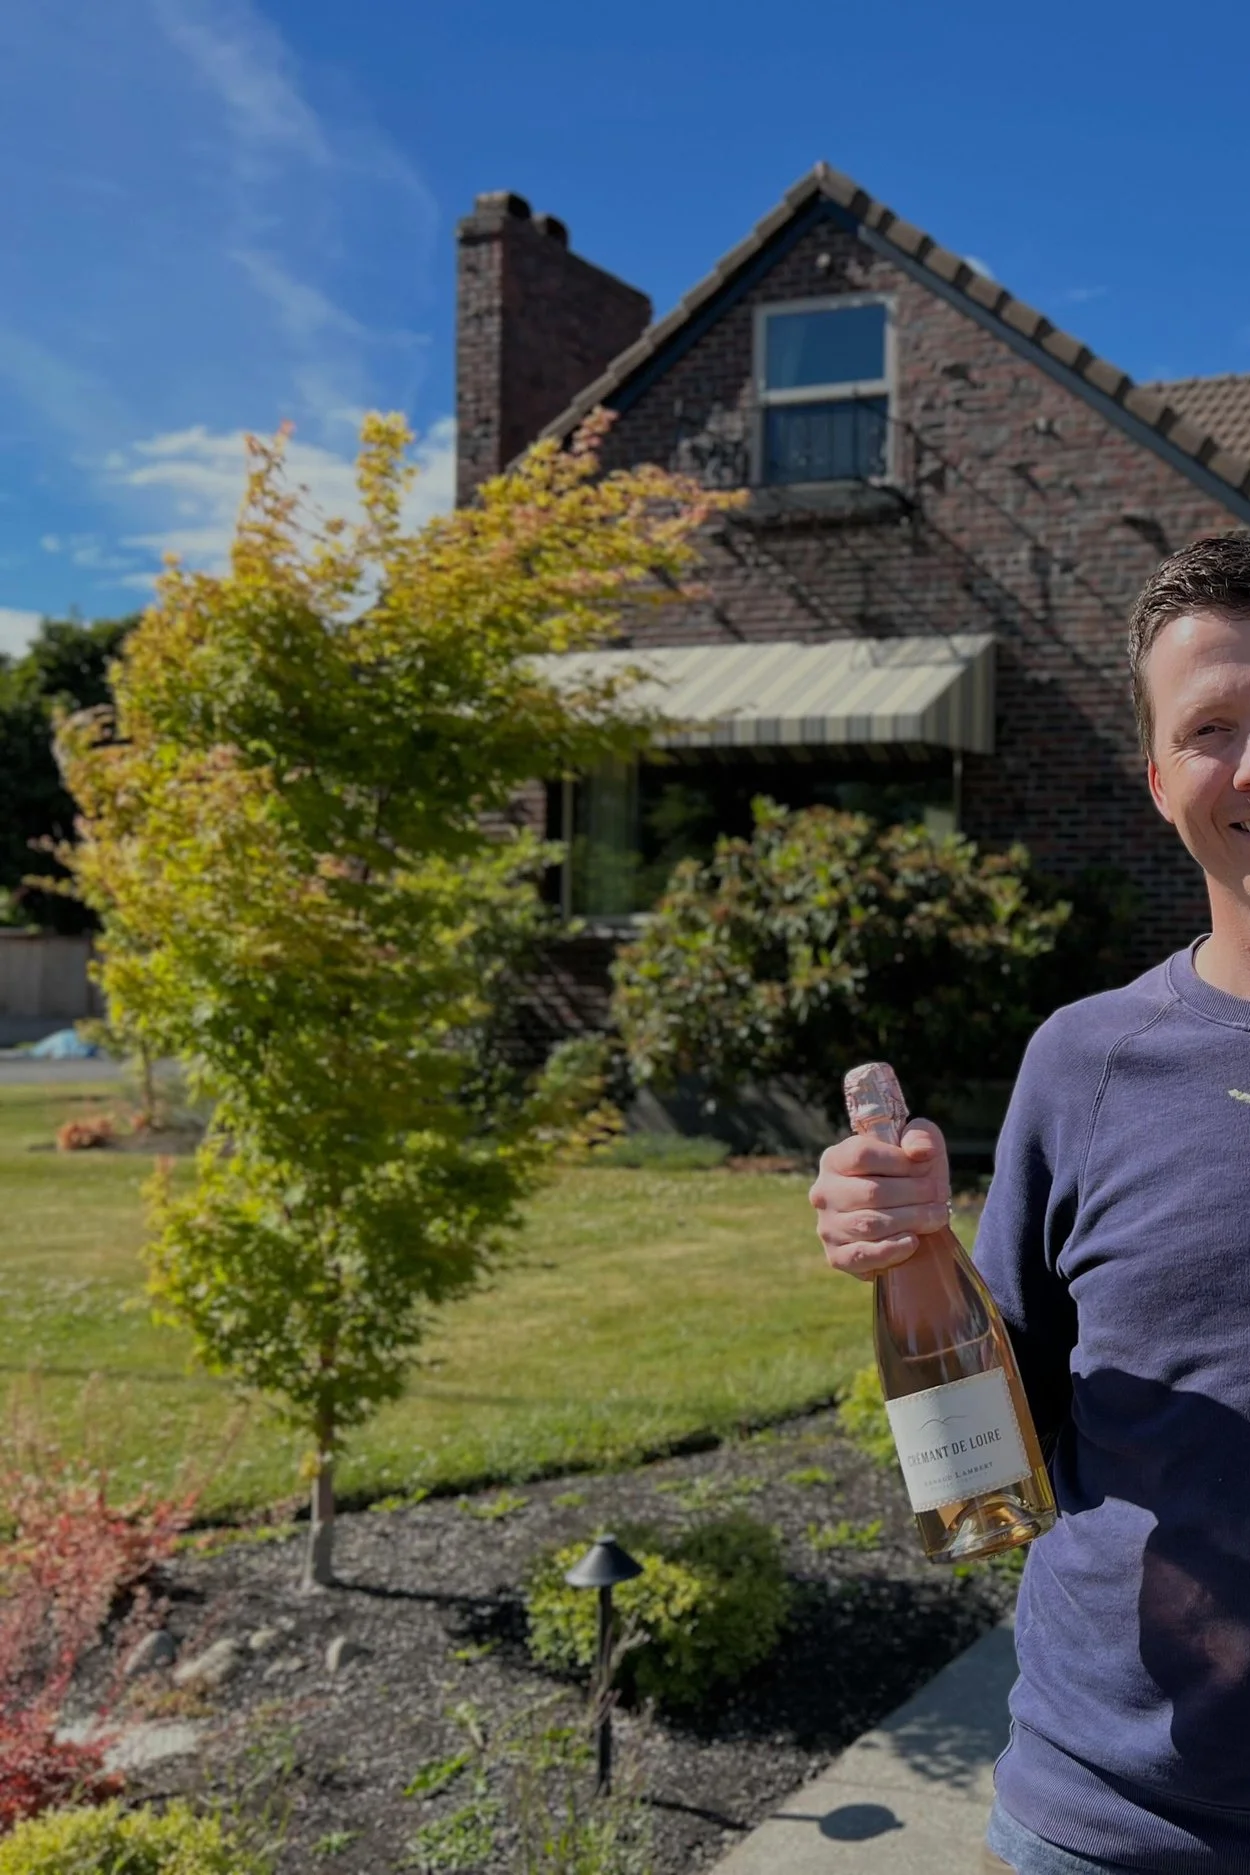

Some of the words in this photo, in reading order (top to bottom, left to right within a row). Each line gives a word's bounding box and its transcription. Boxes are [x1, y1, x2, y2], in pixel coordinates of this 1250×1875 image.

[951, 1440, 968, 1455] DE
[969, 1428, 1002, 1450] LOIRE
[955, 1461, 993, 1478] LAMBERT
